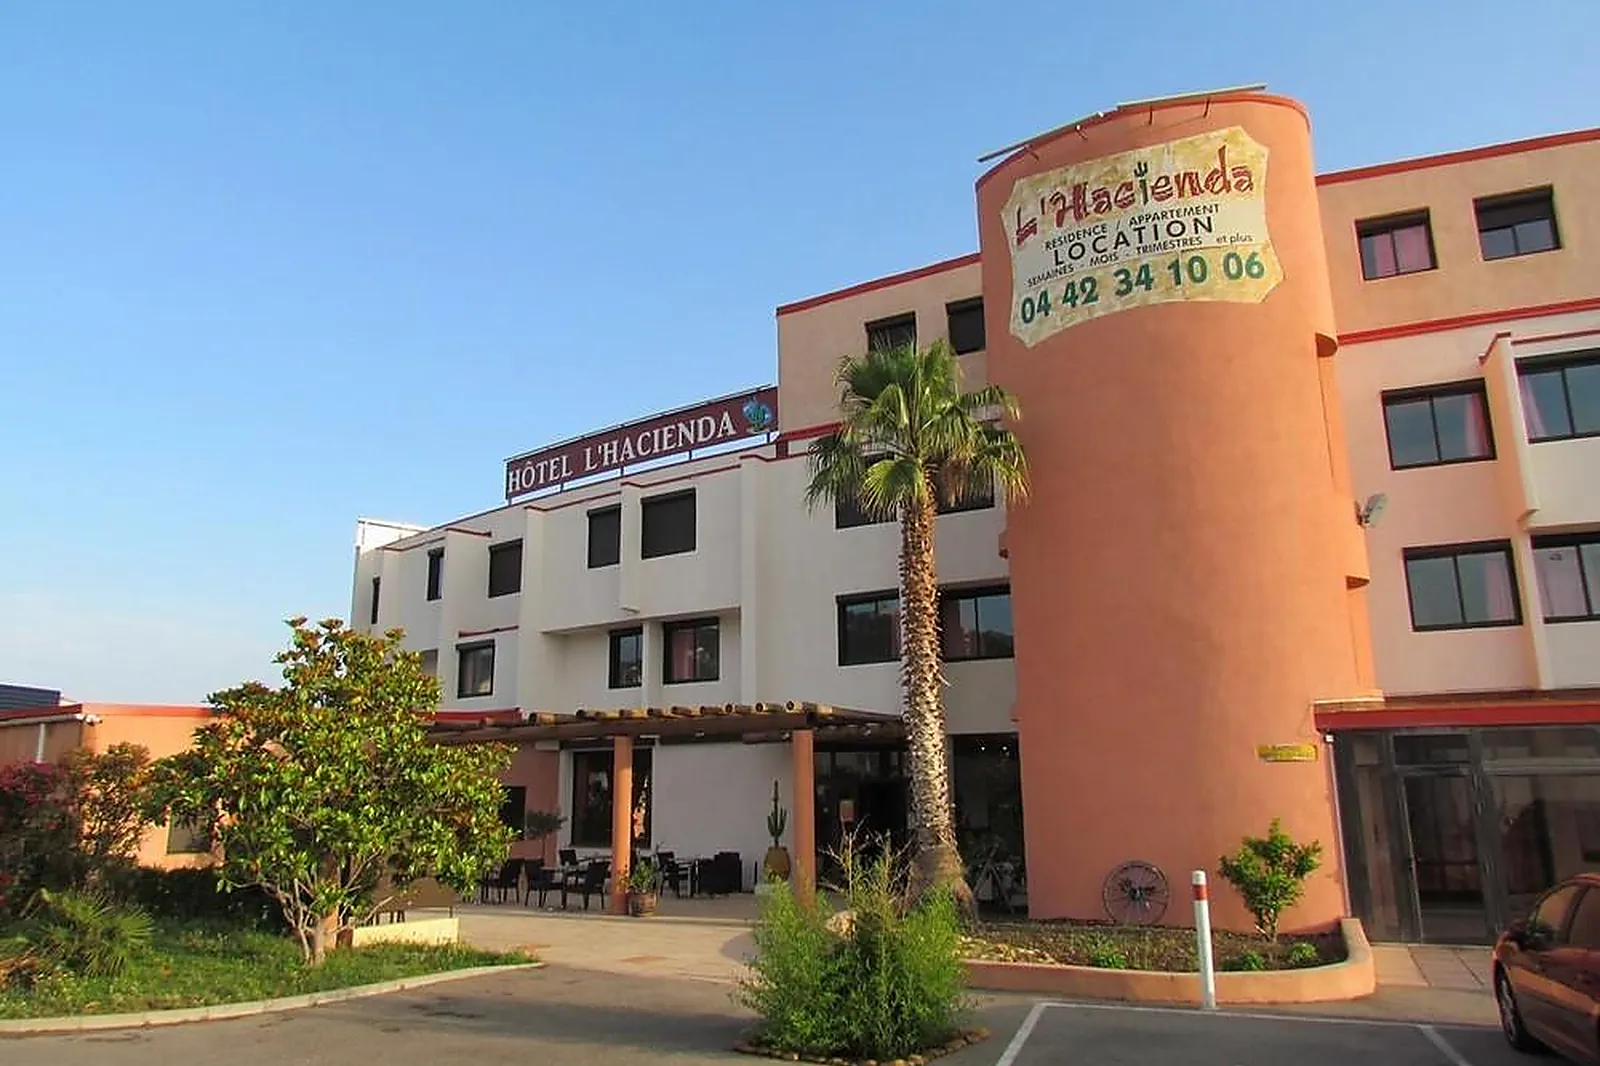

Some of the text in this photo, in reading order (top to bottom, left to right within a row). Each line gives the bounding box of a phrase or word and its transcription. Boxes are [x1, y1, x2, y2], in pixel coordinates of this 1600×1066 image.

[1015, 145, 1254, 245] L'Hacienda
[1129, 203, 1220, 228] APPARTEMENT
[1027, 263, 1074, 288] SEMAINES
[1090, 252, 1119, 266] MOIS
[1136, 236, 1203, 256] TRIMESTRES
[1216, 235, 1227, 243] et
[1229, 232, 1253, 247] plus
[1054, 216, 1215, 266] LOCATION
[1021, 252, 1265, 324] 04 42 34 10 06
[508, 410, 737, 493] HÔTEL L'HACIENDA
